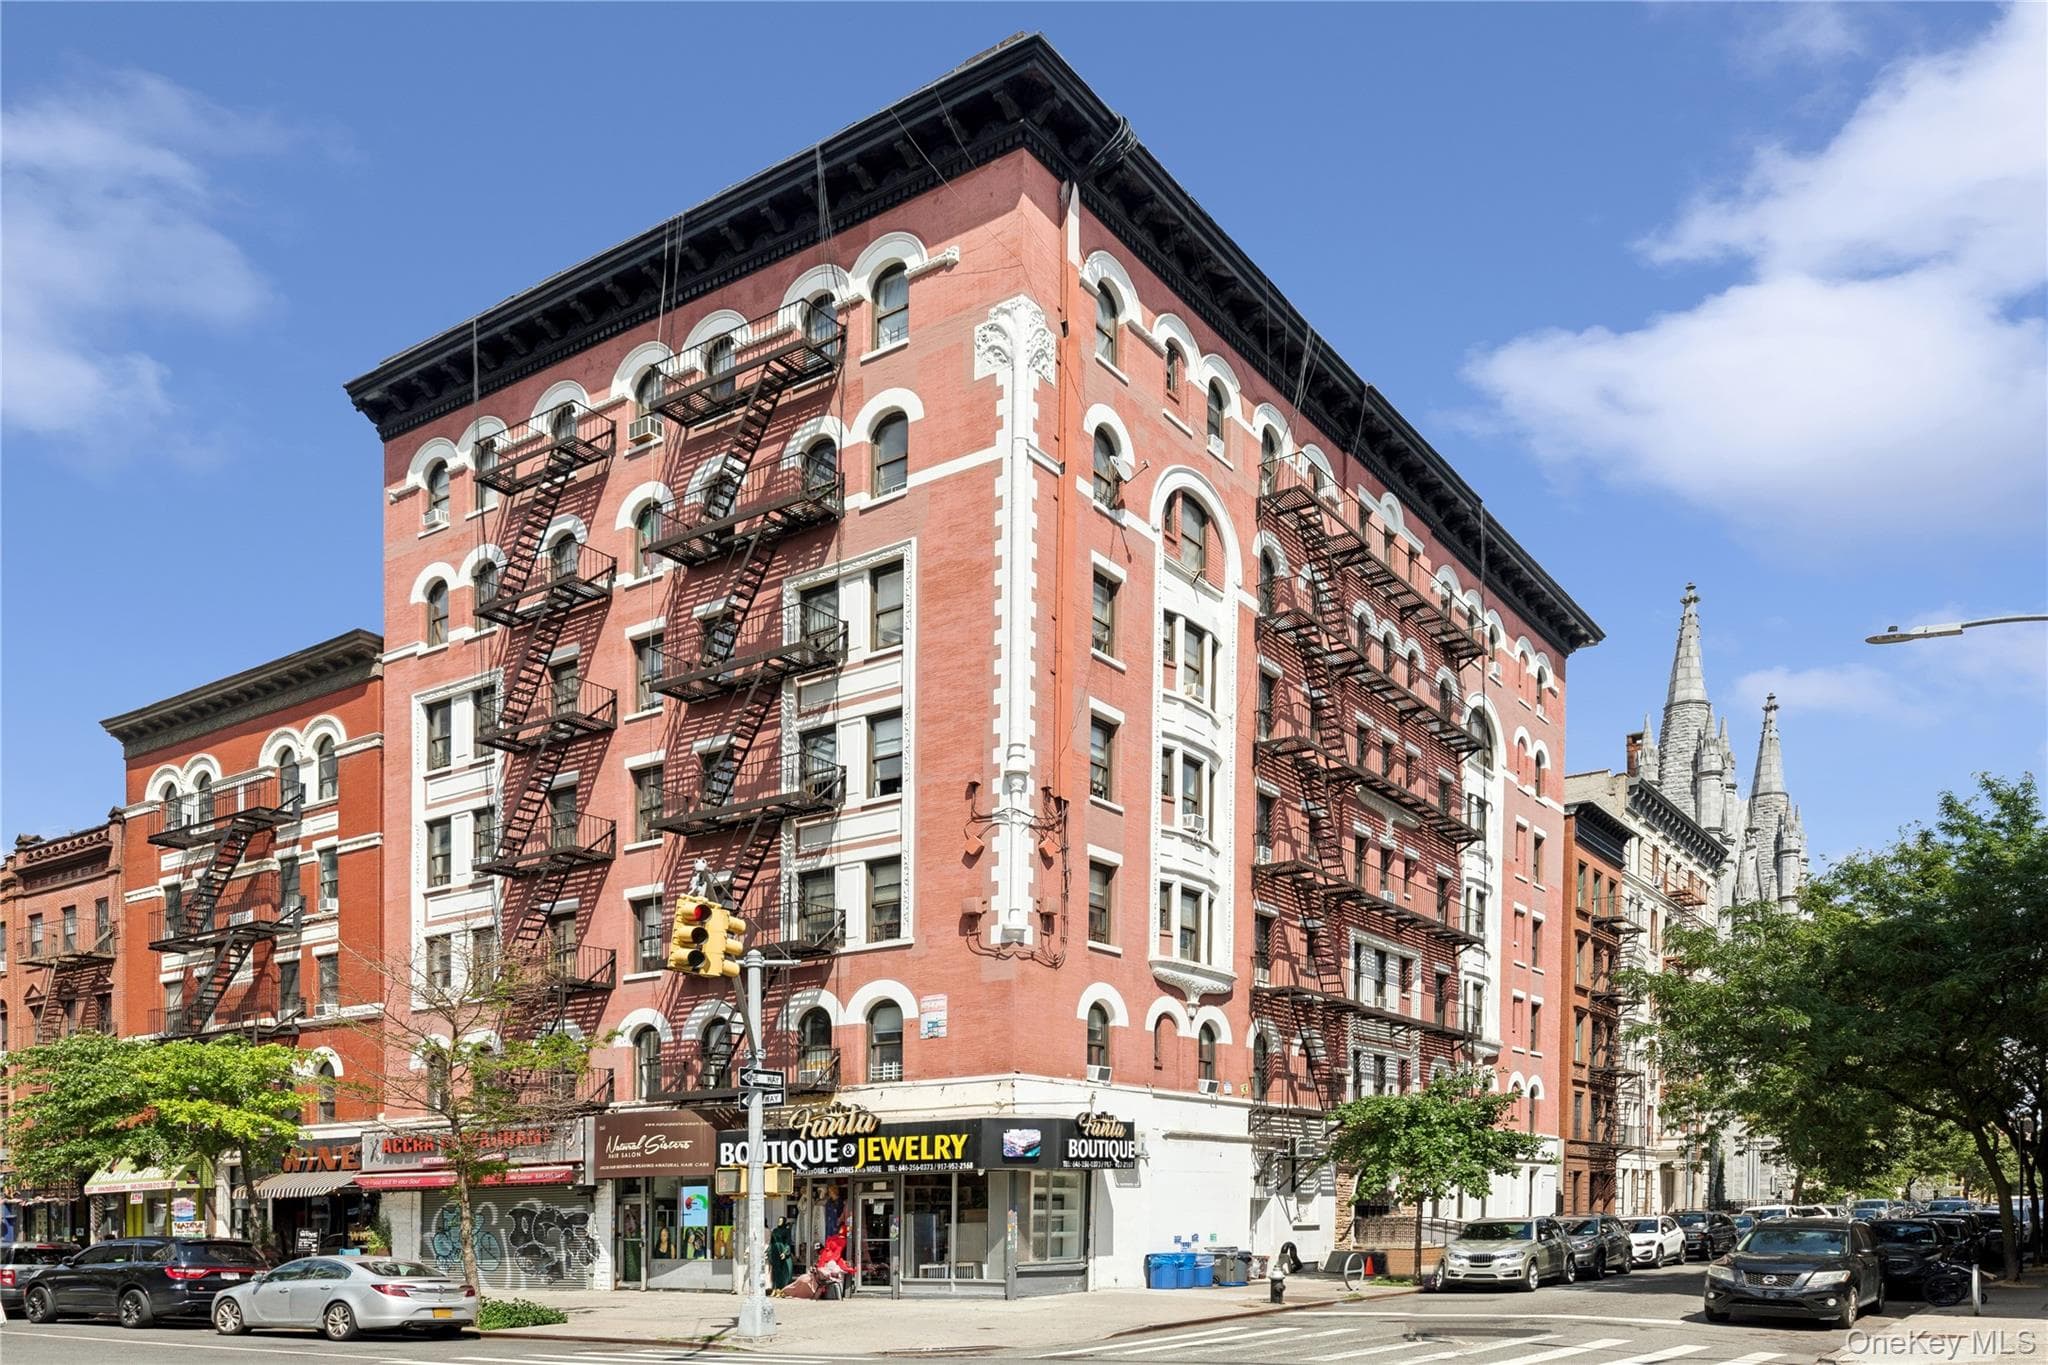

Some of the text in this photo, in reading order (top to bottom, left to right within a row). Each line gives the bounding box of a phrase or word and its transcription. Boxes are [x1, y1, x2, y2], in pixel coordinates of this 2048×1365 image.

[789, 1103, 879, 1140] Fanta
[1079, 1110, 1126, 1138] Fanta
[381, 1135, 435, 1154] ACCRA
[606, 1134, 694, 1155] Natural Sisters
[854, 1133, 969, 1169] JEWELRY
[1067, 1138, 1135, 1163] BOUTIQUE
[282, 1143, 362, 1173] WINE
[866, 1165, 882, 1173] MORE
